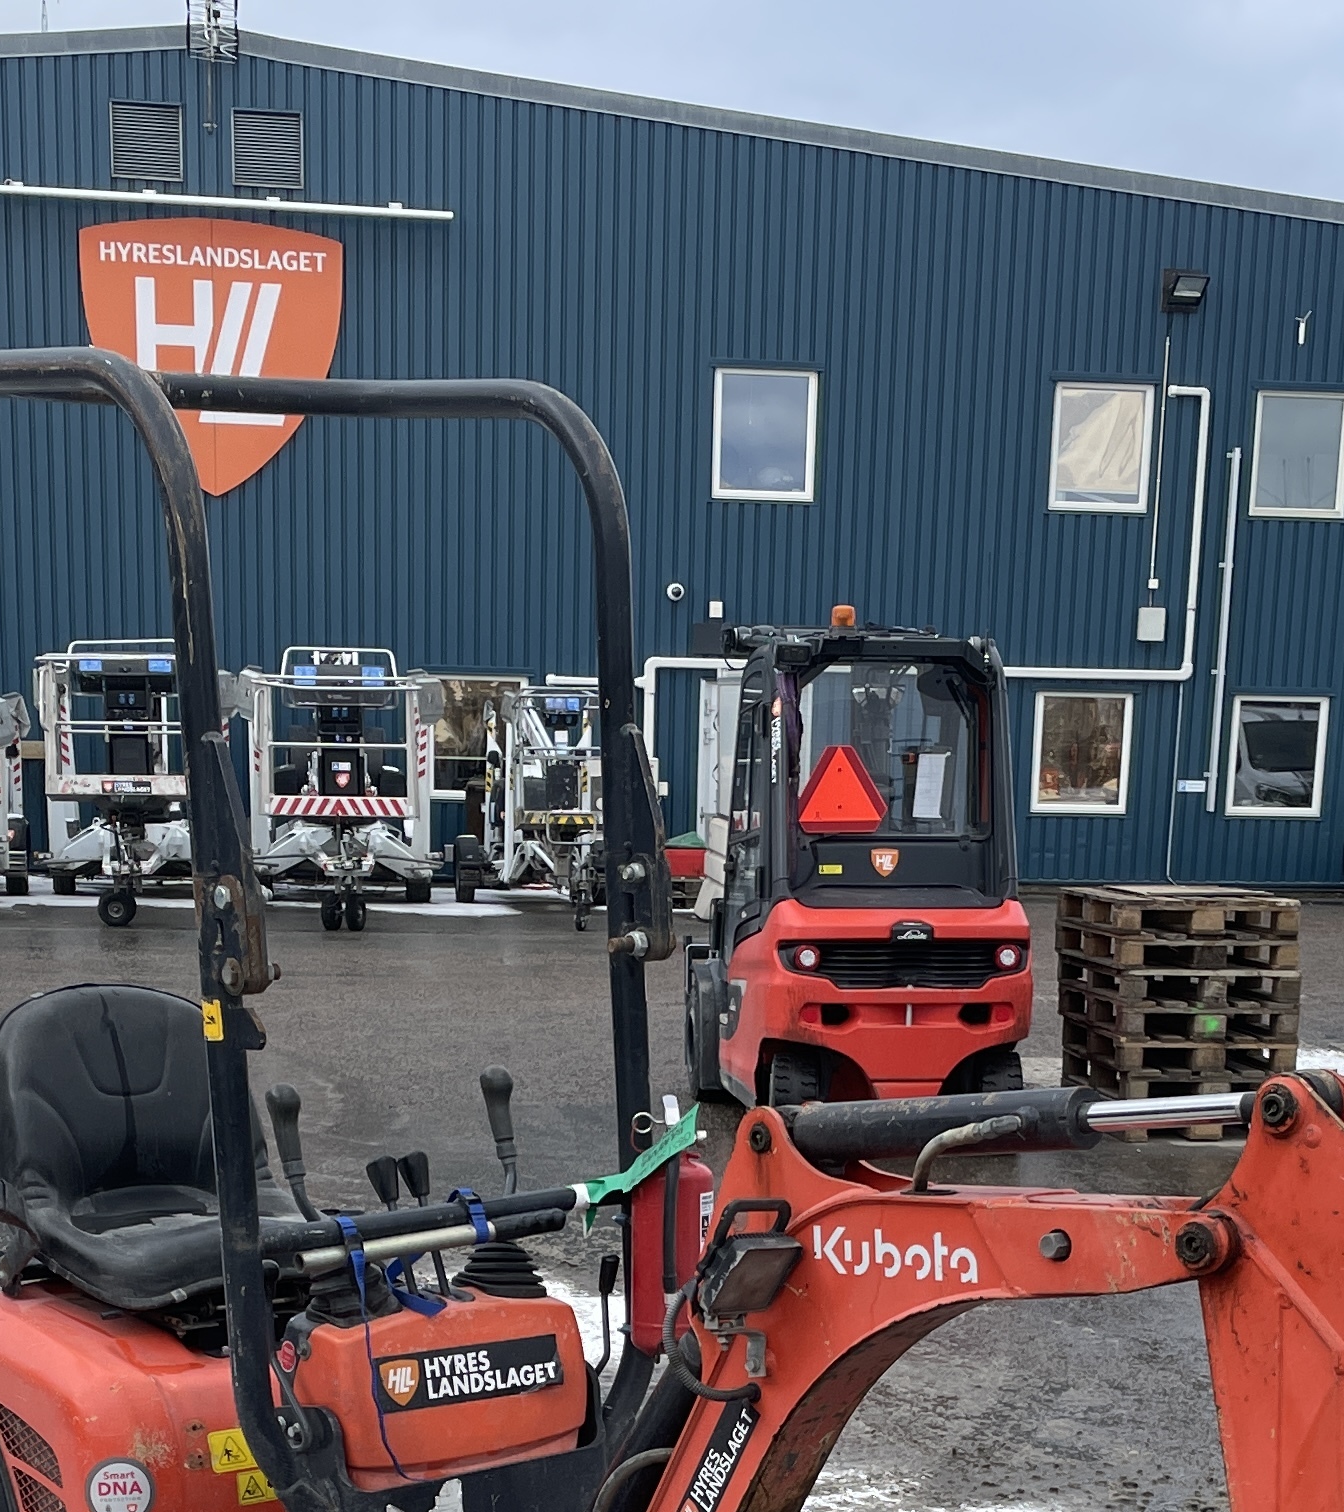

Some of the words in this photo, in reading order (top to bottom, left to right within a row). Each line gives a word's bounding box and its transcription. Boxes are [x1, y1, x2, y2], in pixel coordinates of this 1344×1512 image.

[98, 240, 328, 274] HYRESLANDSLAGET
[812, 1224, 979, 1284] Kubota
[423, 1350, 491, 1379] HYRES
[426, 1361, 557, 1400] LANDSLAGET
[98, 1481, 143, 1497] DNA
[102, 1471, 136, 1480] Smart
[689, 1448, 721, 1504] HYRES
